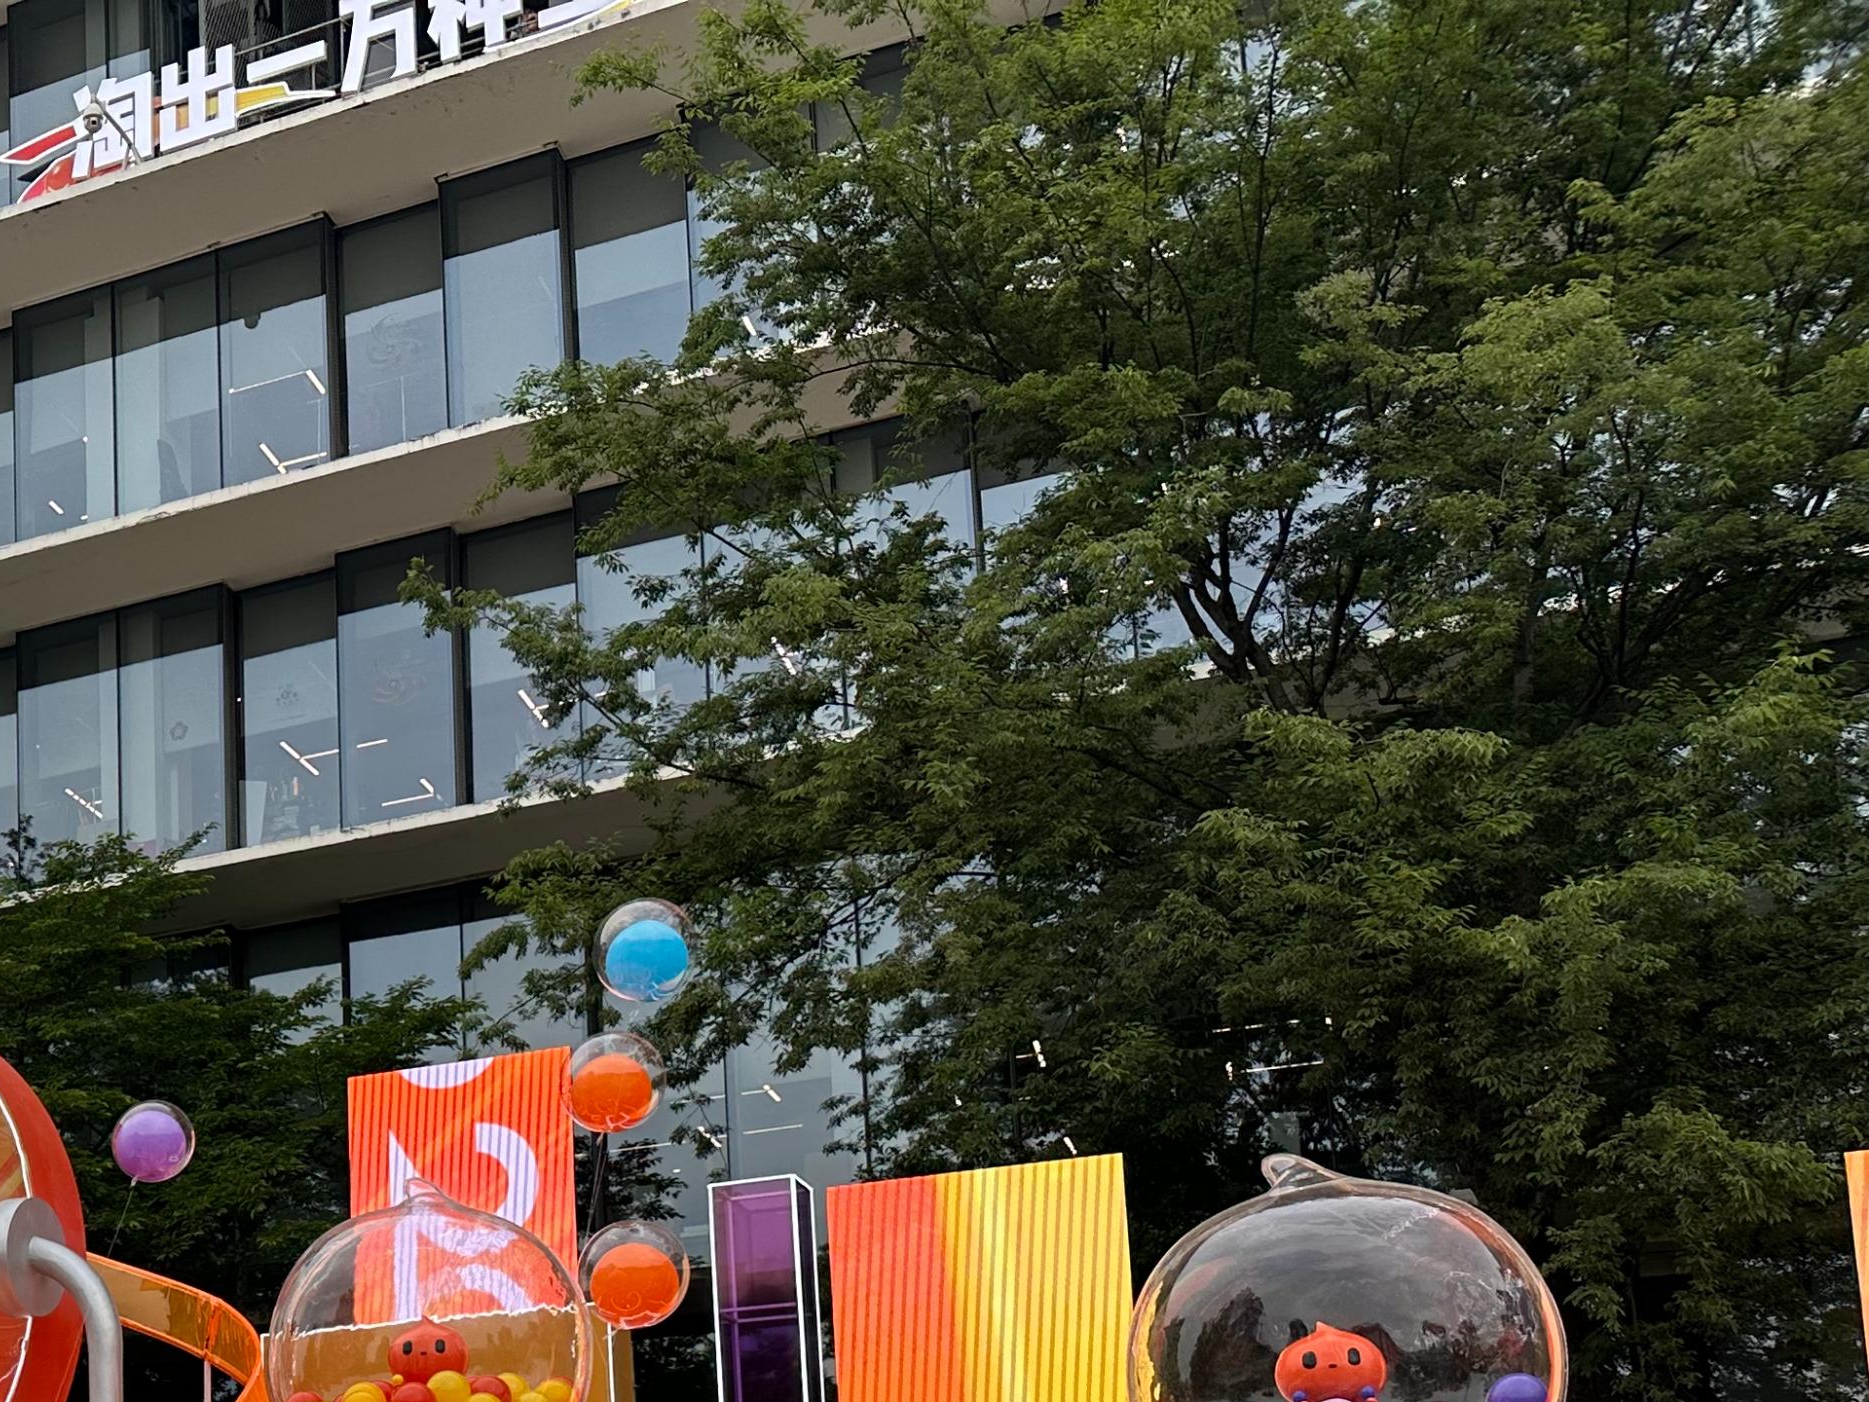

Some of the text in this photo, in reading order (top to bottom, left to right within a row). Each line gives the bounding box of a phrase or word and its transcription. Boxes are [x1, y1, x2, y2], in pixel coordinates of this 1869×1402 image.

[70, 0, 582, 179] 淘出一万种
